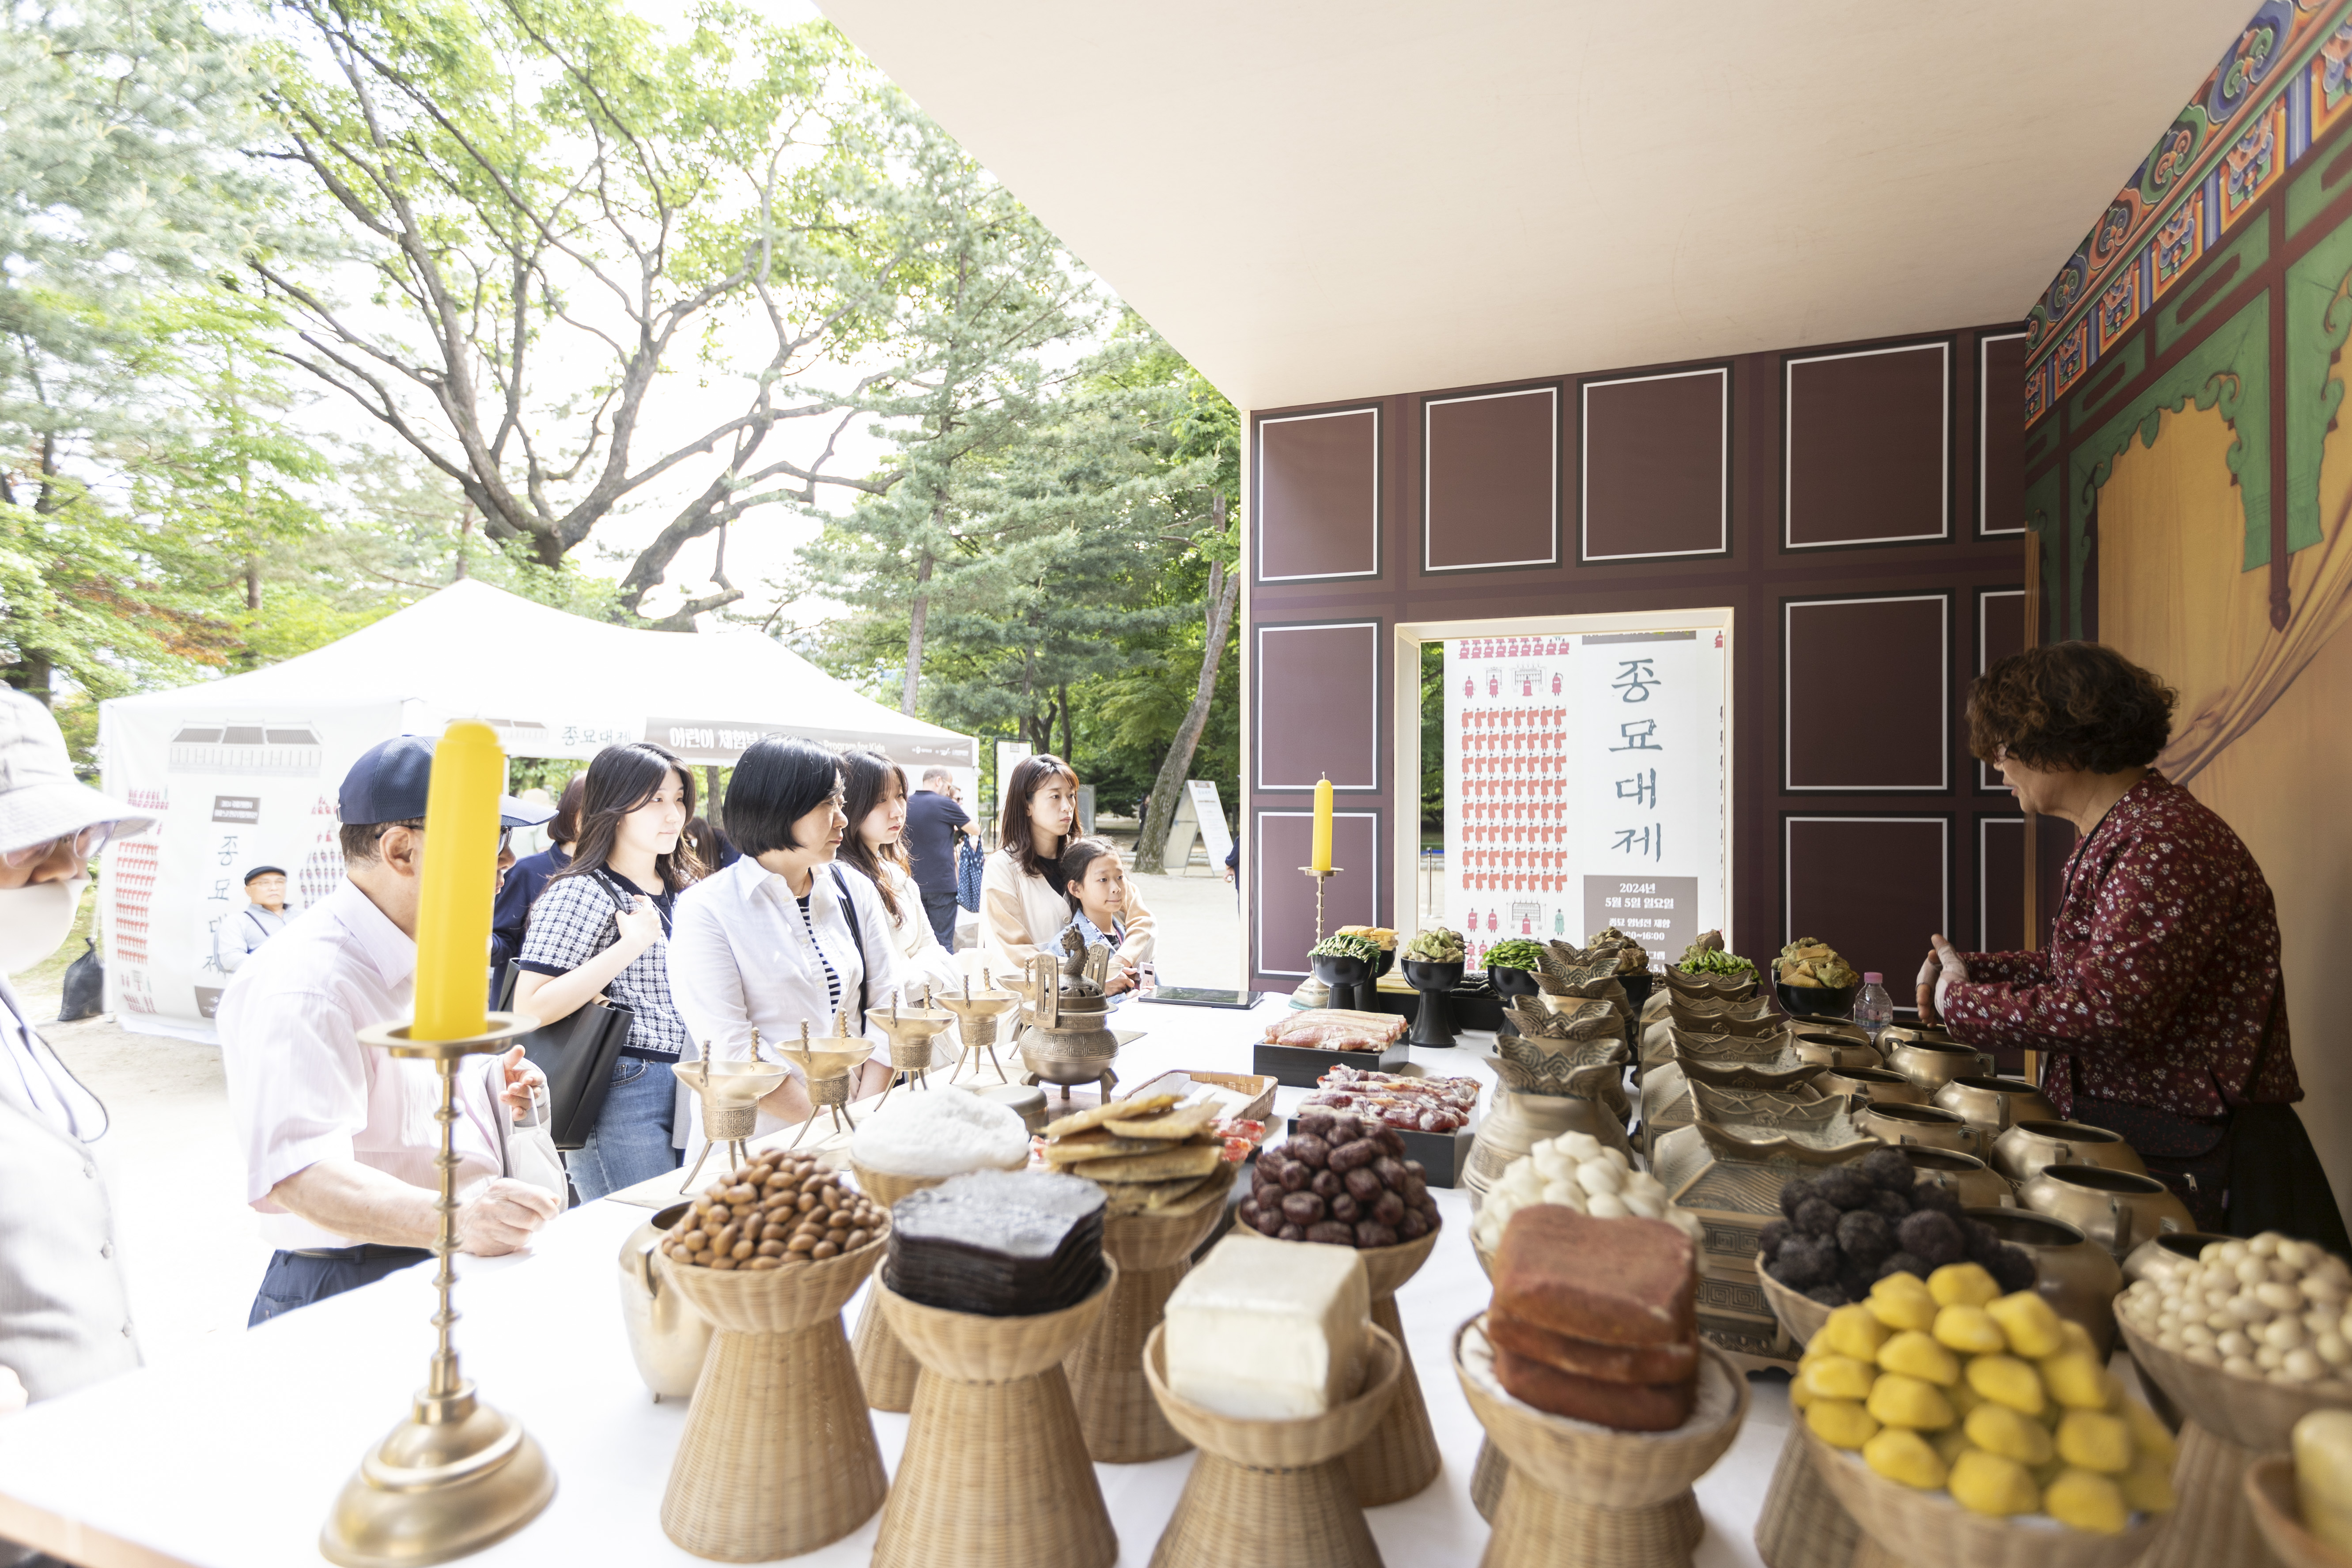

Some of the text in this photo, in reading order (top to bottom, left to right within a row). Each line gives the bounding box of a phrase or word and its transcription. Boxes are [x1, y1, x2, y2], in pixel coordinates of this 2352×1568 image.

[562, 726, 630, 745] 종묘대제
[669, 727, 767, 750] 어린이 체험부
[823, 740, 856, 754] Program
[858, 741, 868, 751] for
[869, 742, 885, 752] Kids
[1608, 658, 1663, 862] 종묘대제
[1619, 883, 1656, 894] 2024년
[1605, 897, 1674, 909] 5월 5일 일요일
[1609, 918, 1625, 926] 종묘
